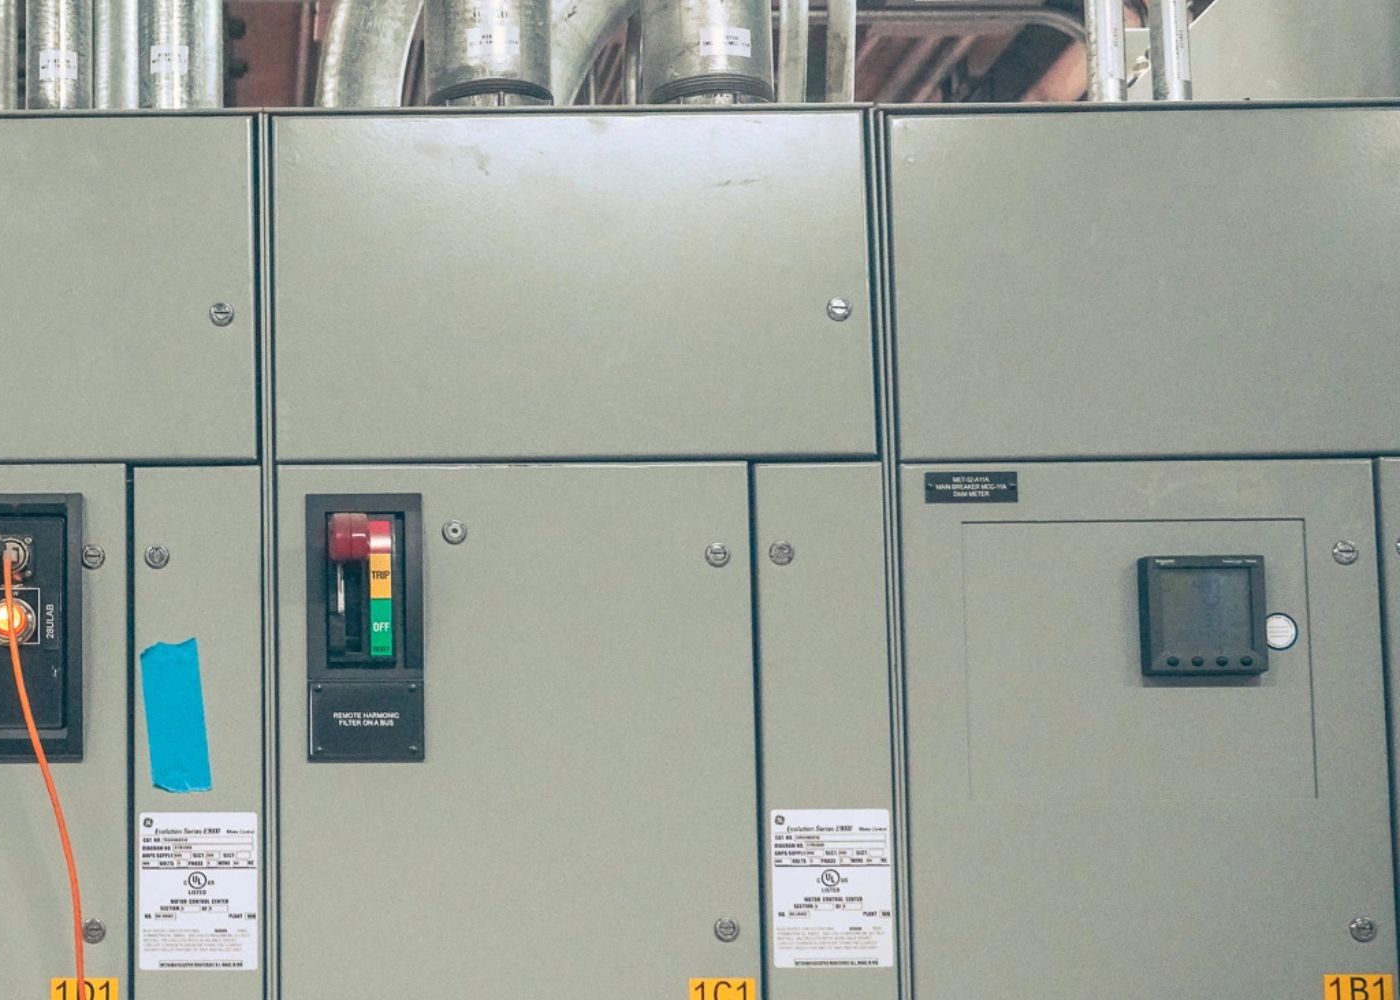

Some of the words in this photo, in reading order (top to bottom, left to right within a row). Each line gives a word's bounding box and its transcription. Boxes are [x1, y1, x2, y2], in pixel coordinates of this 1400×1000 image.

[371, 569, 391, 580] TRIP
[372, 622, 391, 632] OFF
[339, 719, 361, 727] FILTER
[362, 719, 373, 727] ON
[380, 719, 394, 727] BUS
[694, 980, 747, 1000] 1C1
[1330, 976, 1384, 1000] 1B1
